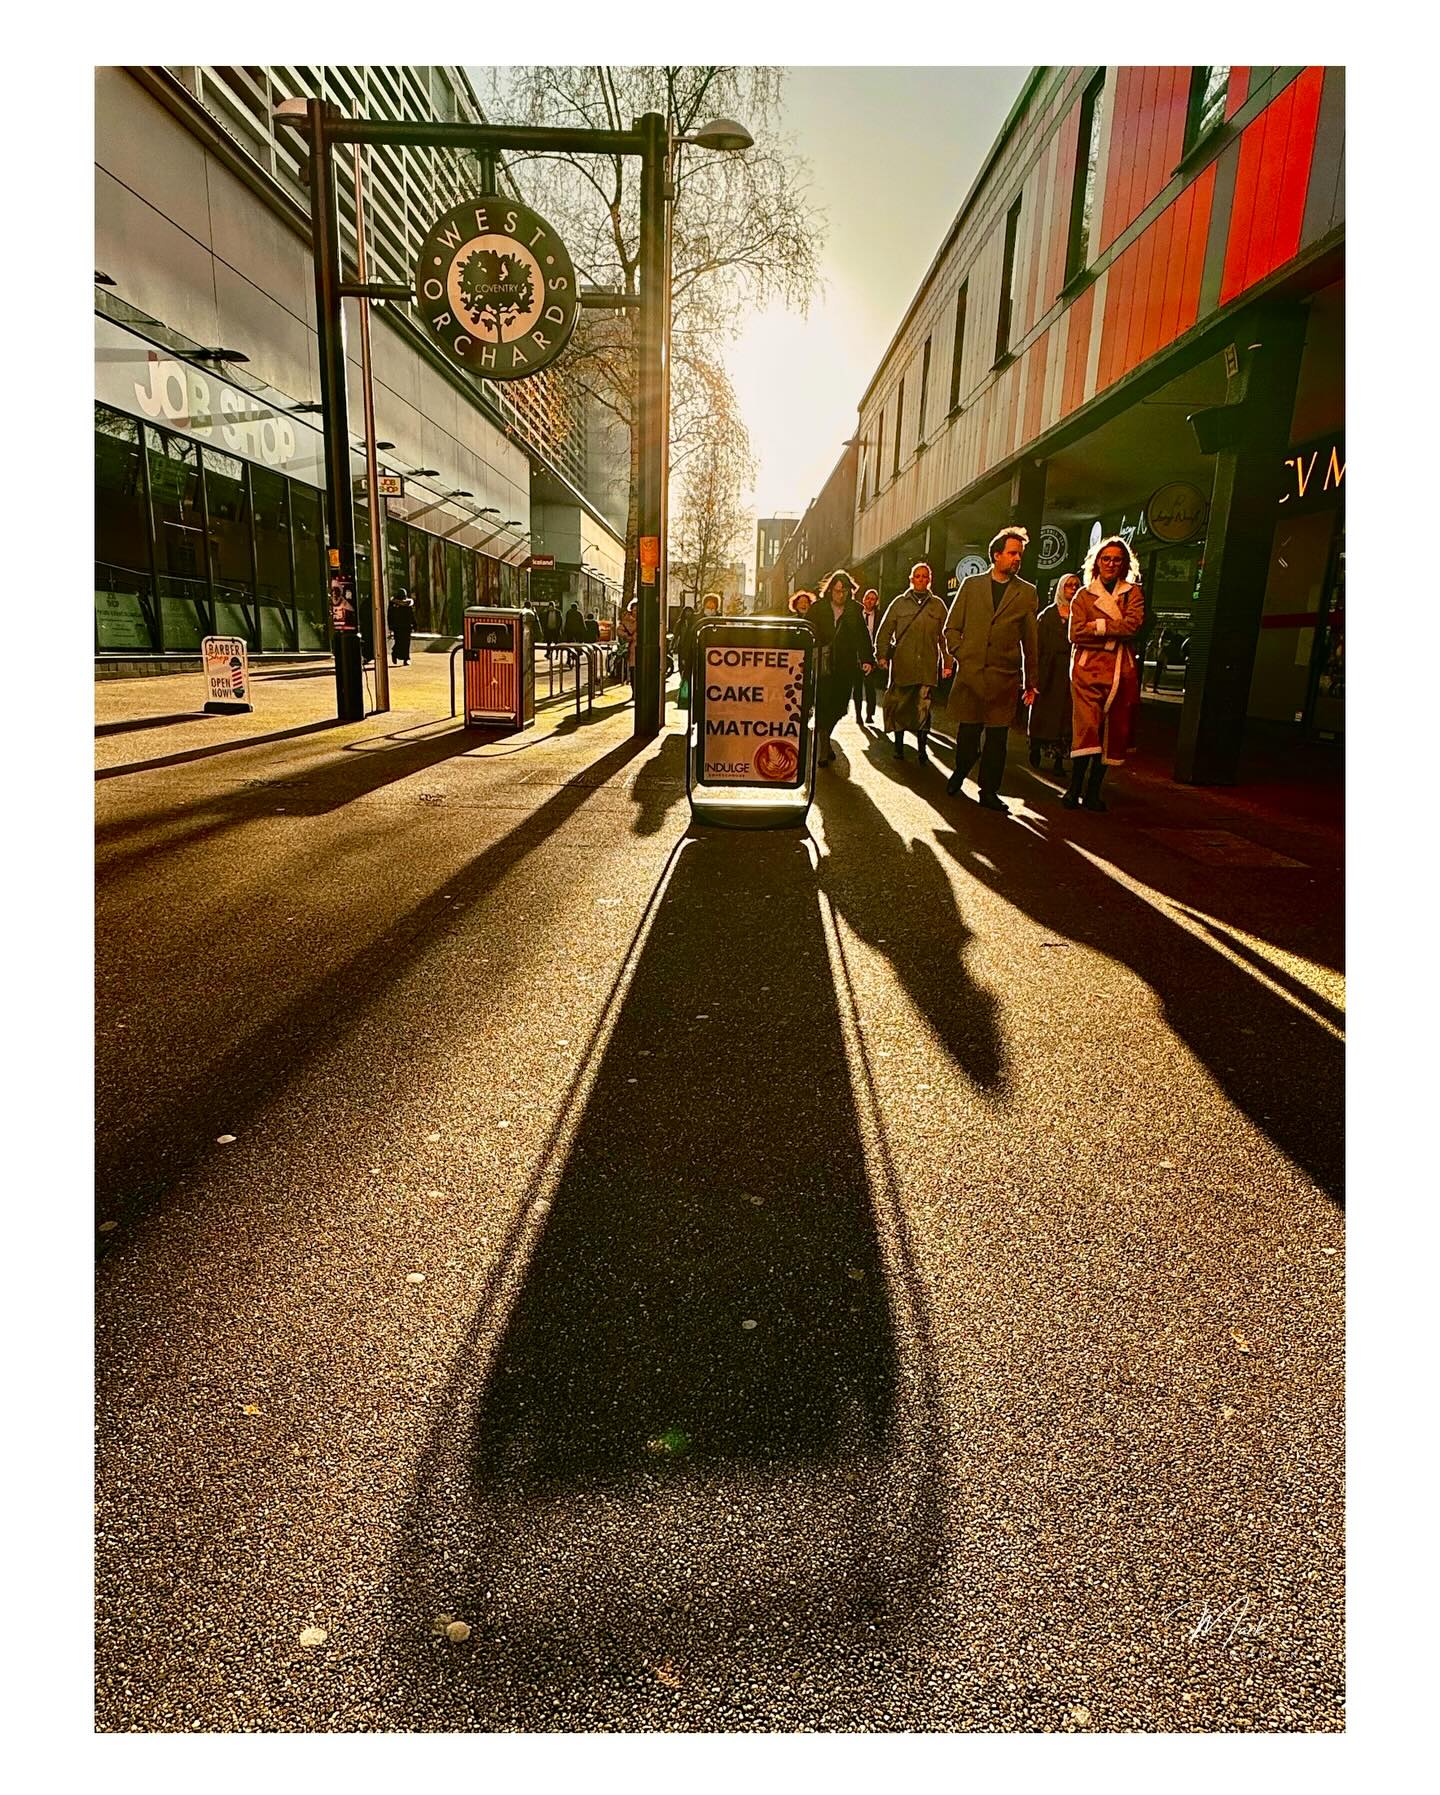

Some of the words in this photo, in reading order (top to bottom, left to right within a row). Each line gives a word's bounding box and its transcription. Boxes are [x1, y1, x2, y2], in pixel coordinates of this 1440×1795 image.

[437, 208, 546, 250] WEST
[475, 284, 519, 294] COVENTRY
[423, 276, 568, 368] ORCHARDS
[134, 350, 213, 437] JOB
[220, 388, 296, 465] SHOP
[209, 644, 240, 656] BARBER
[706, 650, 789, 668] COFFEE
[211, 677, 231, 688] OPEN
[212, 688, 232, 698] NOW!
[706, 685, 764, 702] CAKE
[706, 720, 799, 737] MATCHA
